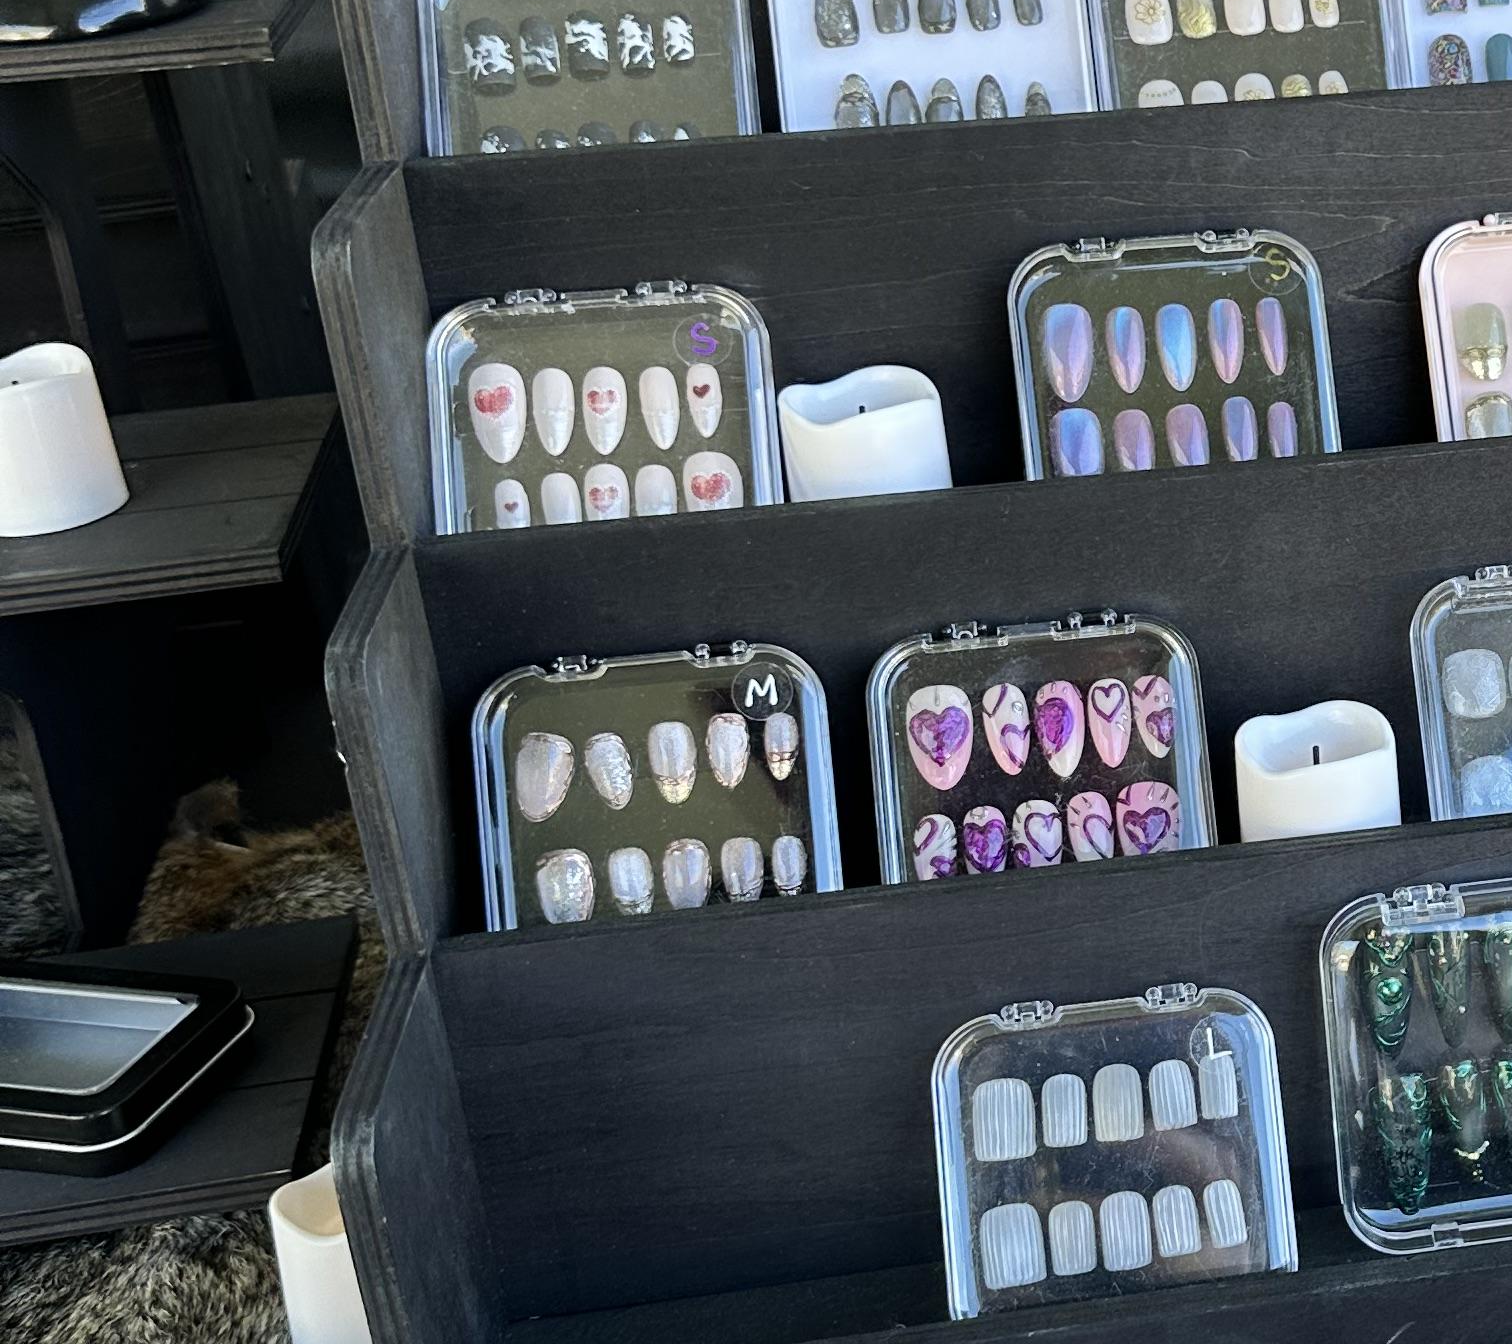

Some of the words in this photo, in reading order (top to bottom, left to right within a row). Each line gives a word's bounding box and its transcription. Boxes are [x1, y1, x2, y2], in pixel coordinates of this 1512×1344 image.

[1264, 247, 1292, 281] S
[690, 322, 718, 355] S
[744, 672, 779, 708] M
[1206, 1026, 1233, 1061] L
